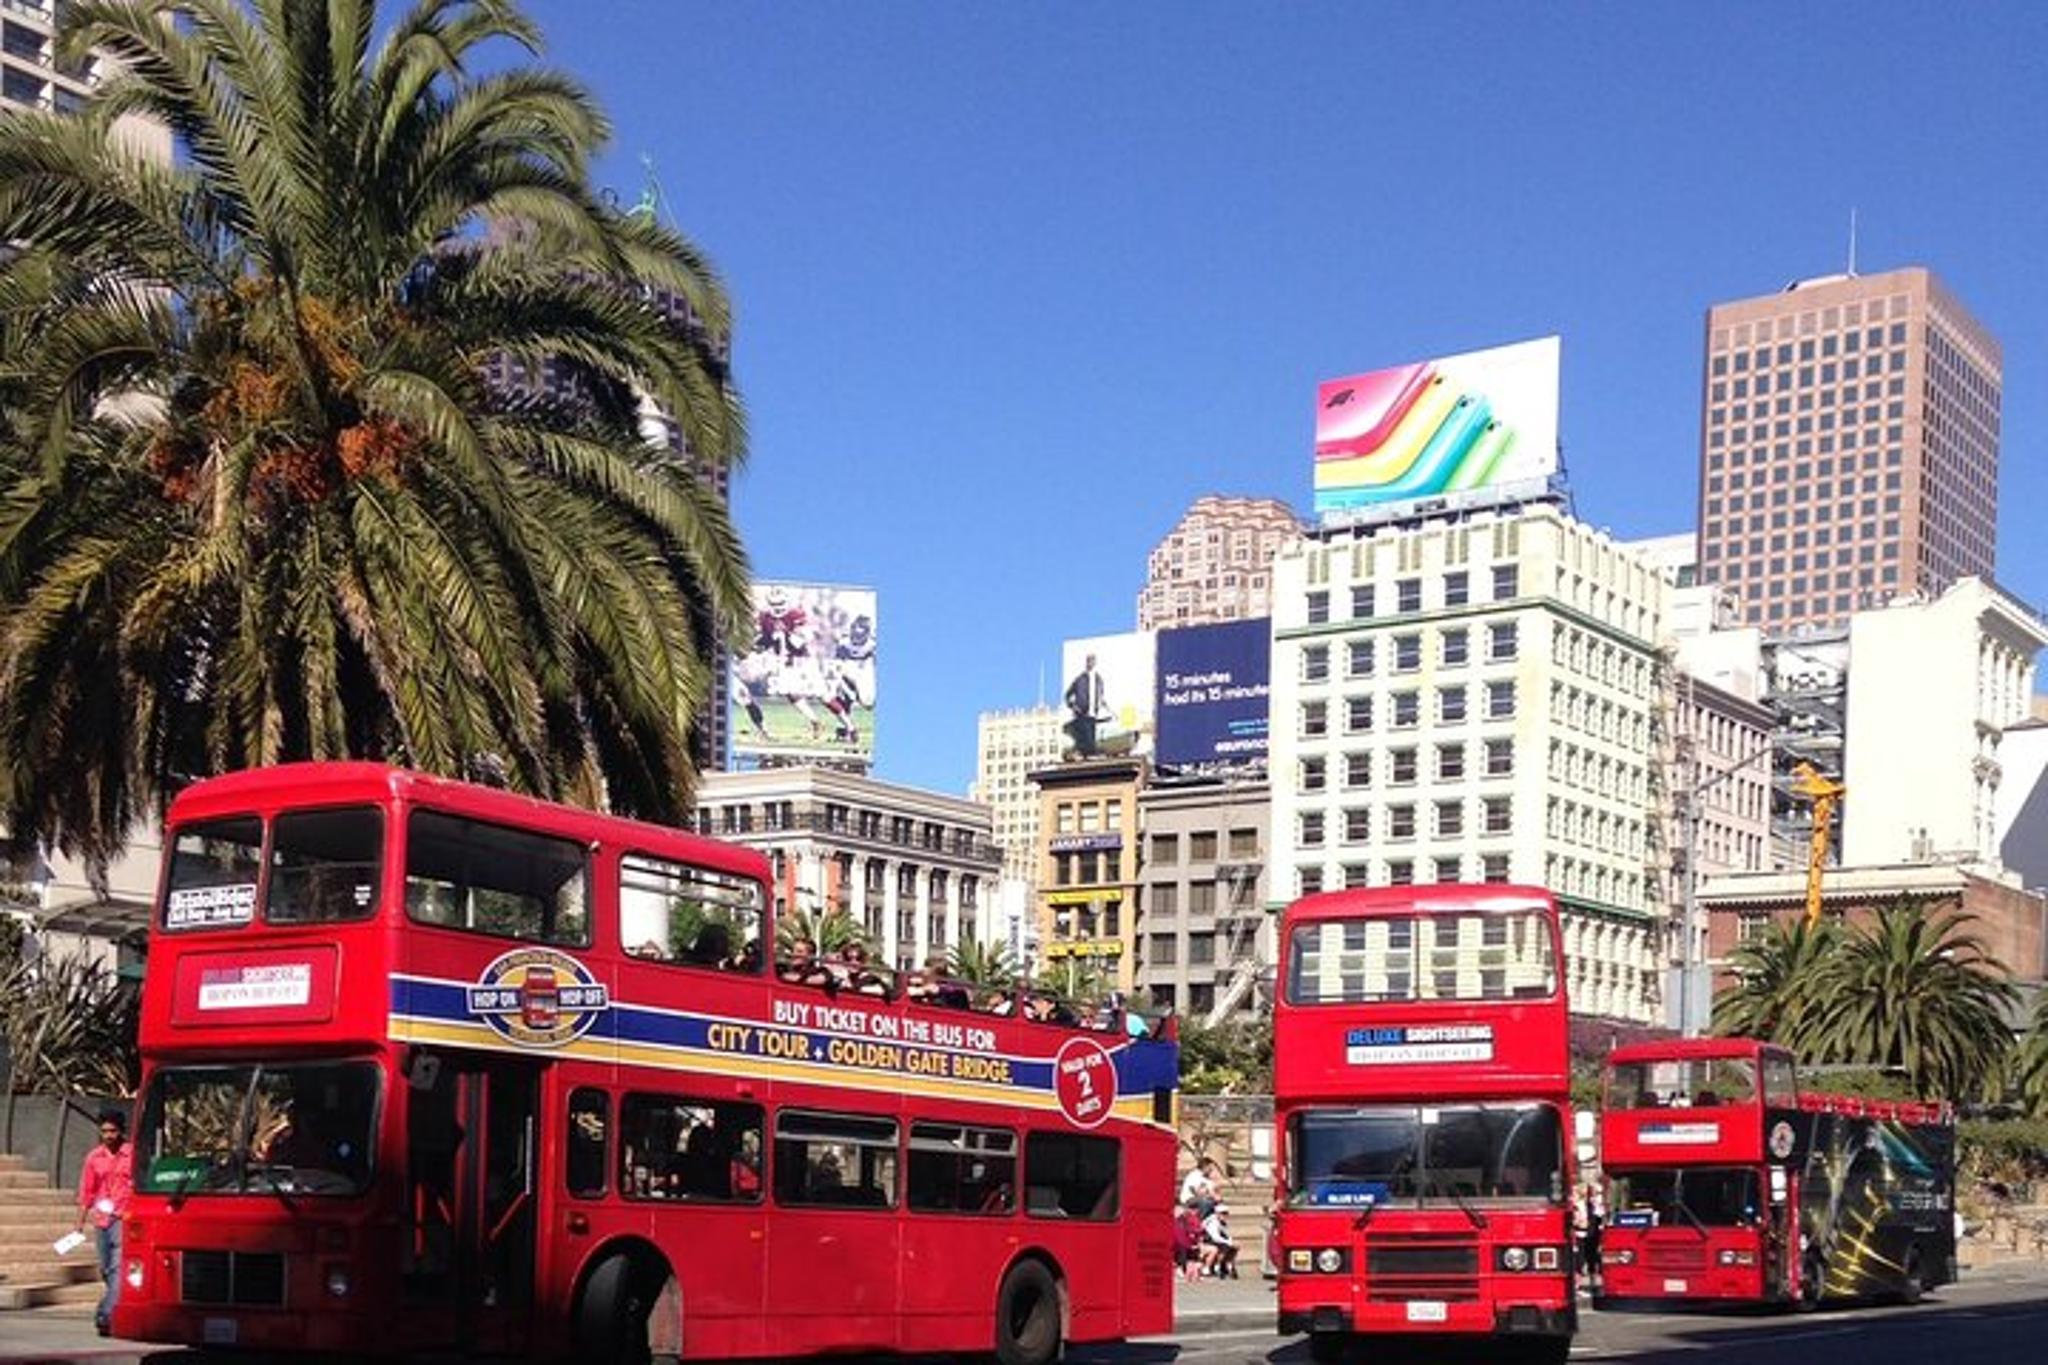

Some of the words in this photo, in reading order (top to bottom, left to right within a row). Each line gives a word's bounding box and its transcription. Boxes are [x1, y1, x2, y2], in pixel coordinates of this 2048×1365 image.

[1164, 690, 1190, 706] had
[1208, 686, 1221, 701] 15
[1223, 685, 1268, 700] minute
[1215, 740, 1268, 753] esuranc
[474, 991, 498, 1008] HOP
[774, 1000, 810, 1025] BUY
[814, 1006, 867, 1032] TICKET
[871, 1014, 898, 1037] ON
[902, 1018, 930, 1042] THE
[932, 1023, 964, 1047] BUS
[966, 1028, 997, 1050] FOR
[707, 1023, 752, 1051] CITY
[756, 1029, 810, 1059] TOUR
[828, 1039, 901, 1070] GOLDEN
[906, 1051, 949, 1075] GATE
[1078, 1070, 1094, 1098] 2
